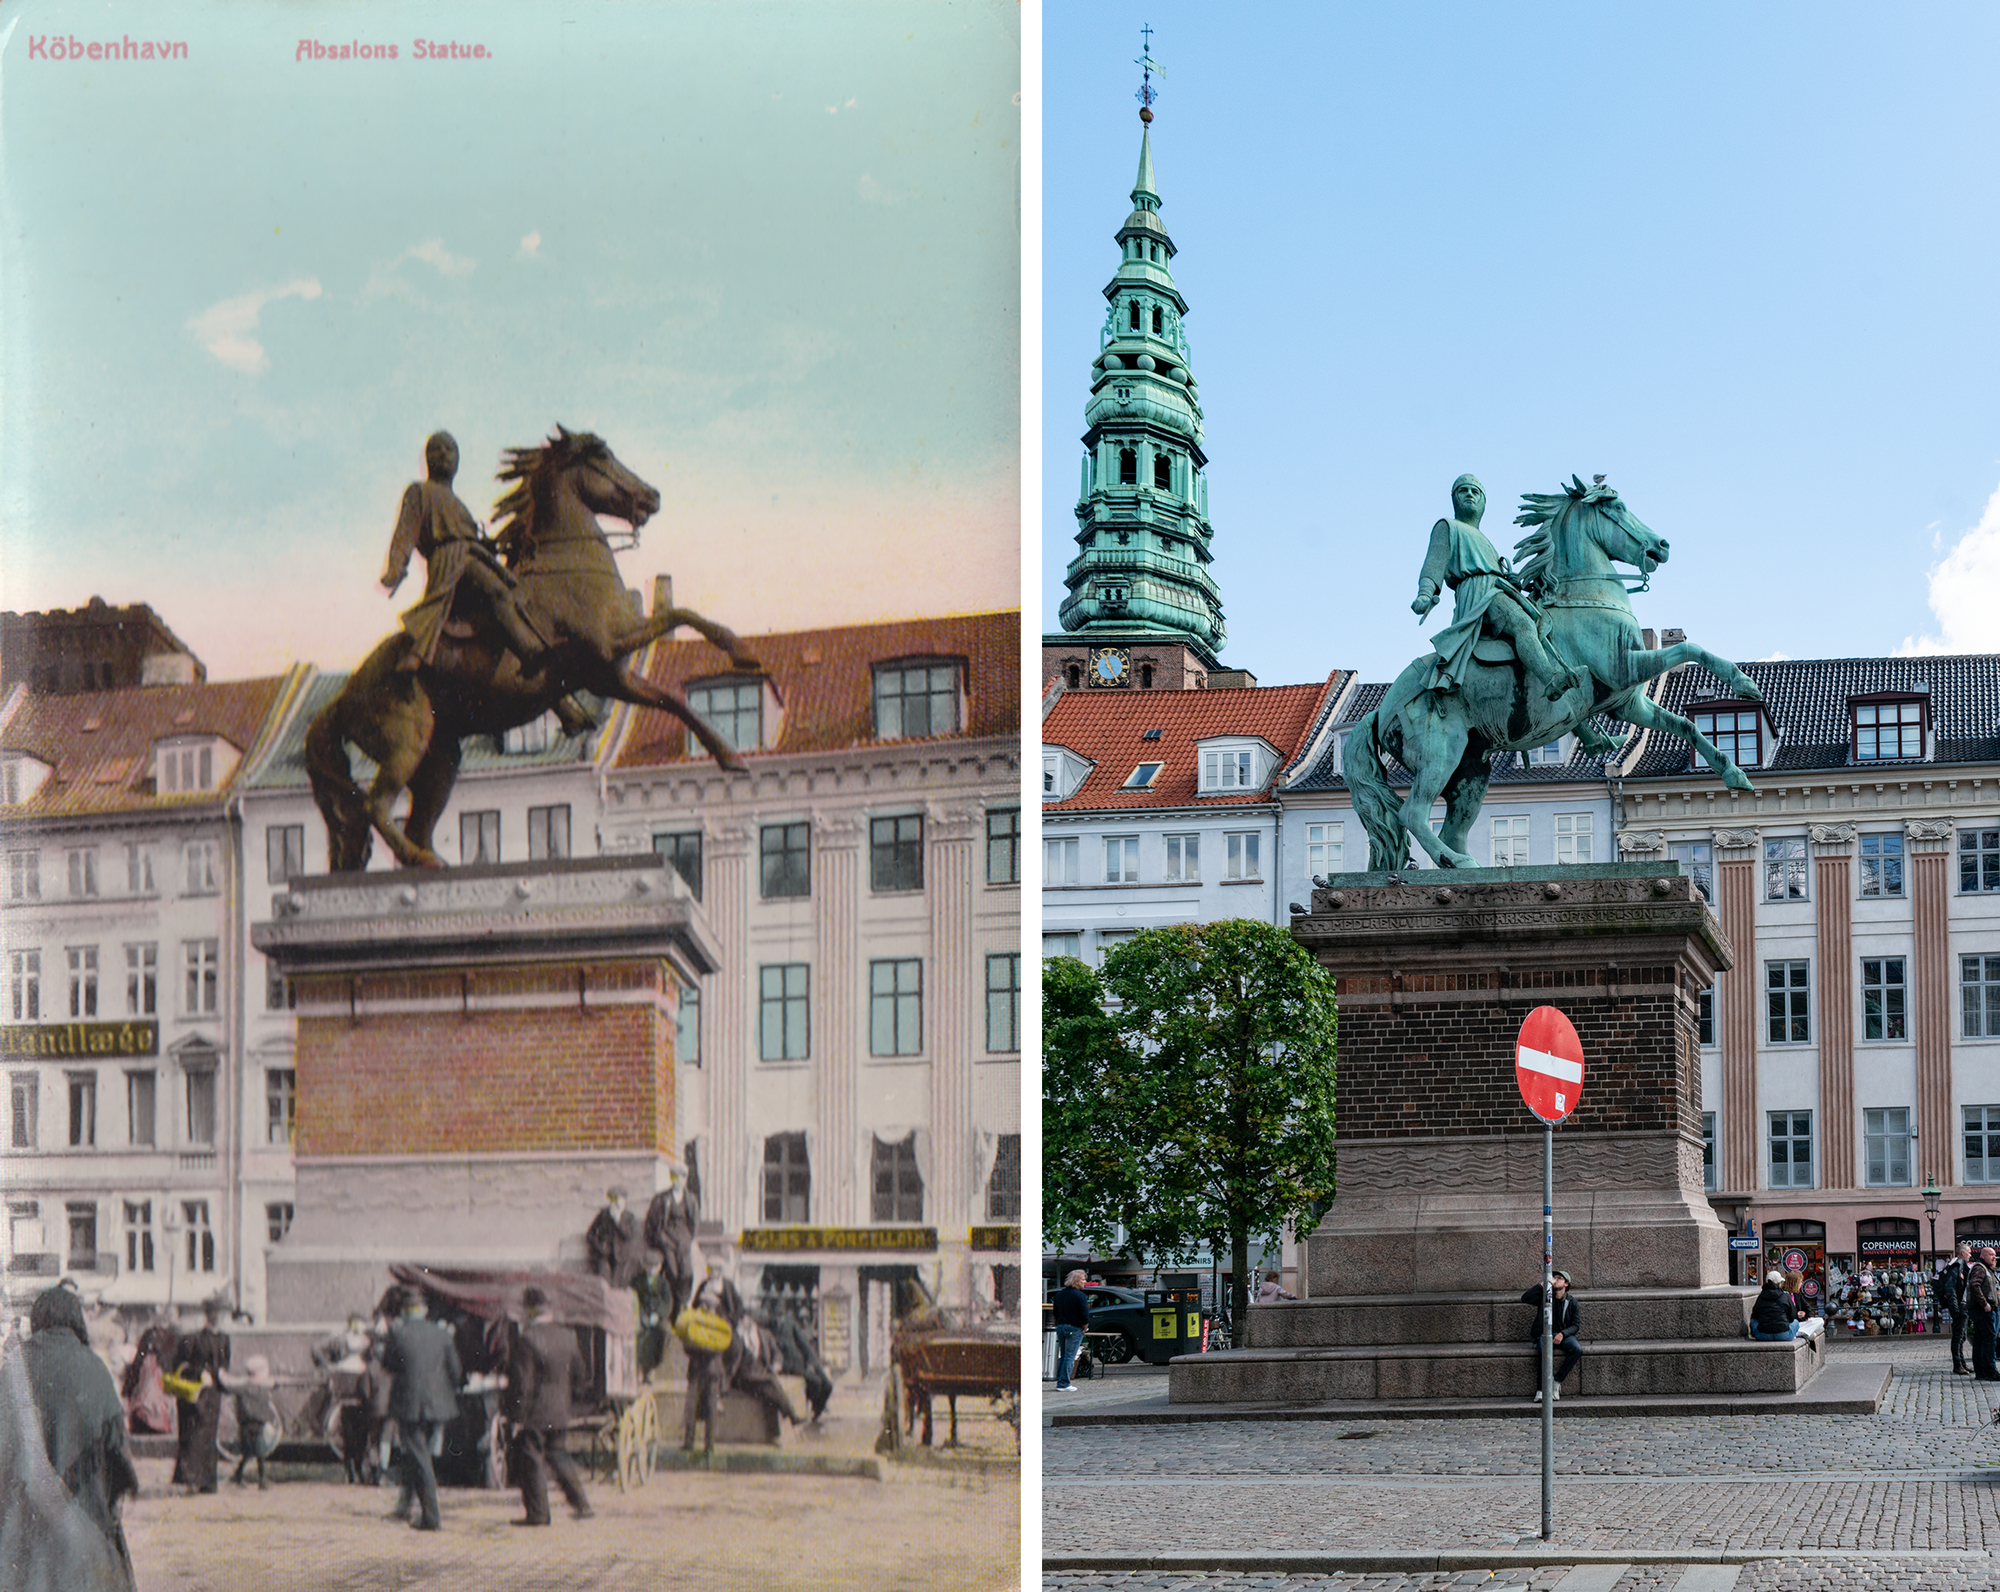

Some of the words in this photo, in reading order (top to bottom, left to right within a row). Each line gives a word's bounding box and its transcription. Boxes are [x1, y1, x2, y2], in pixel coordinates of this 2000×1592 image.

[1332, 919, 1363, 931] MED
[1370, 917, 1400, 929] REN
[1452, 912, 1535, 927] DANMARKS
[1862, 1241, 1917, 1250] COPENHAGEN
